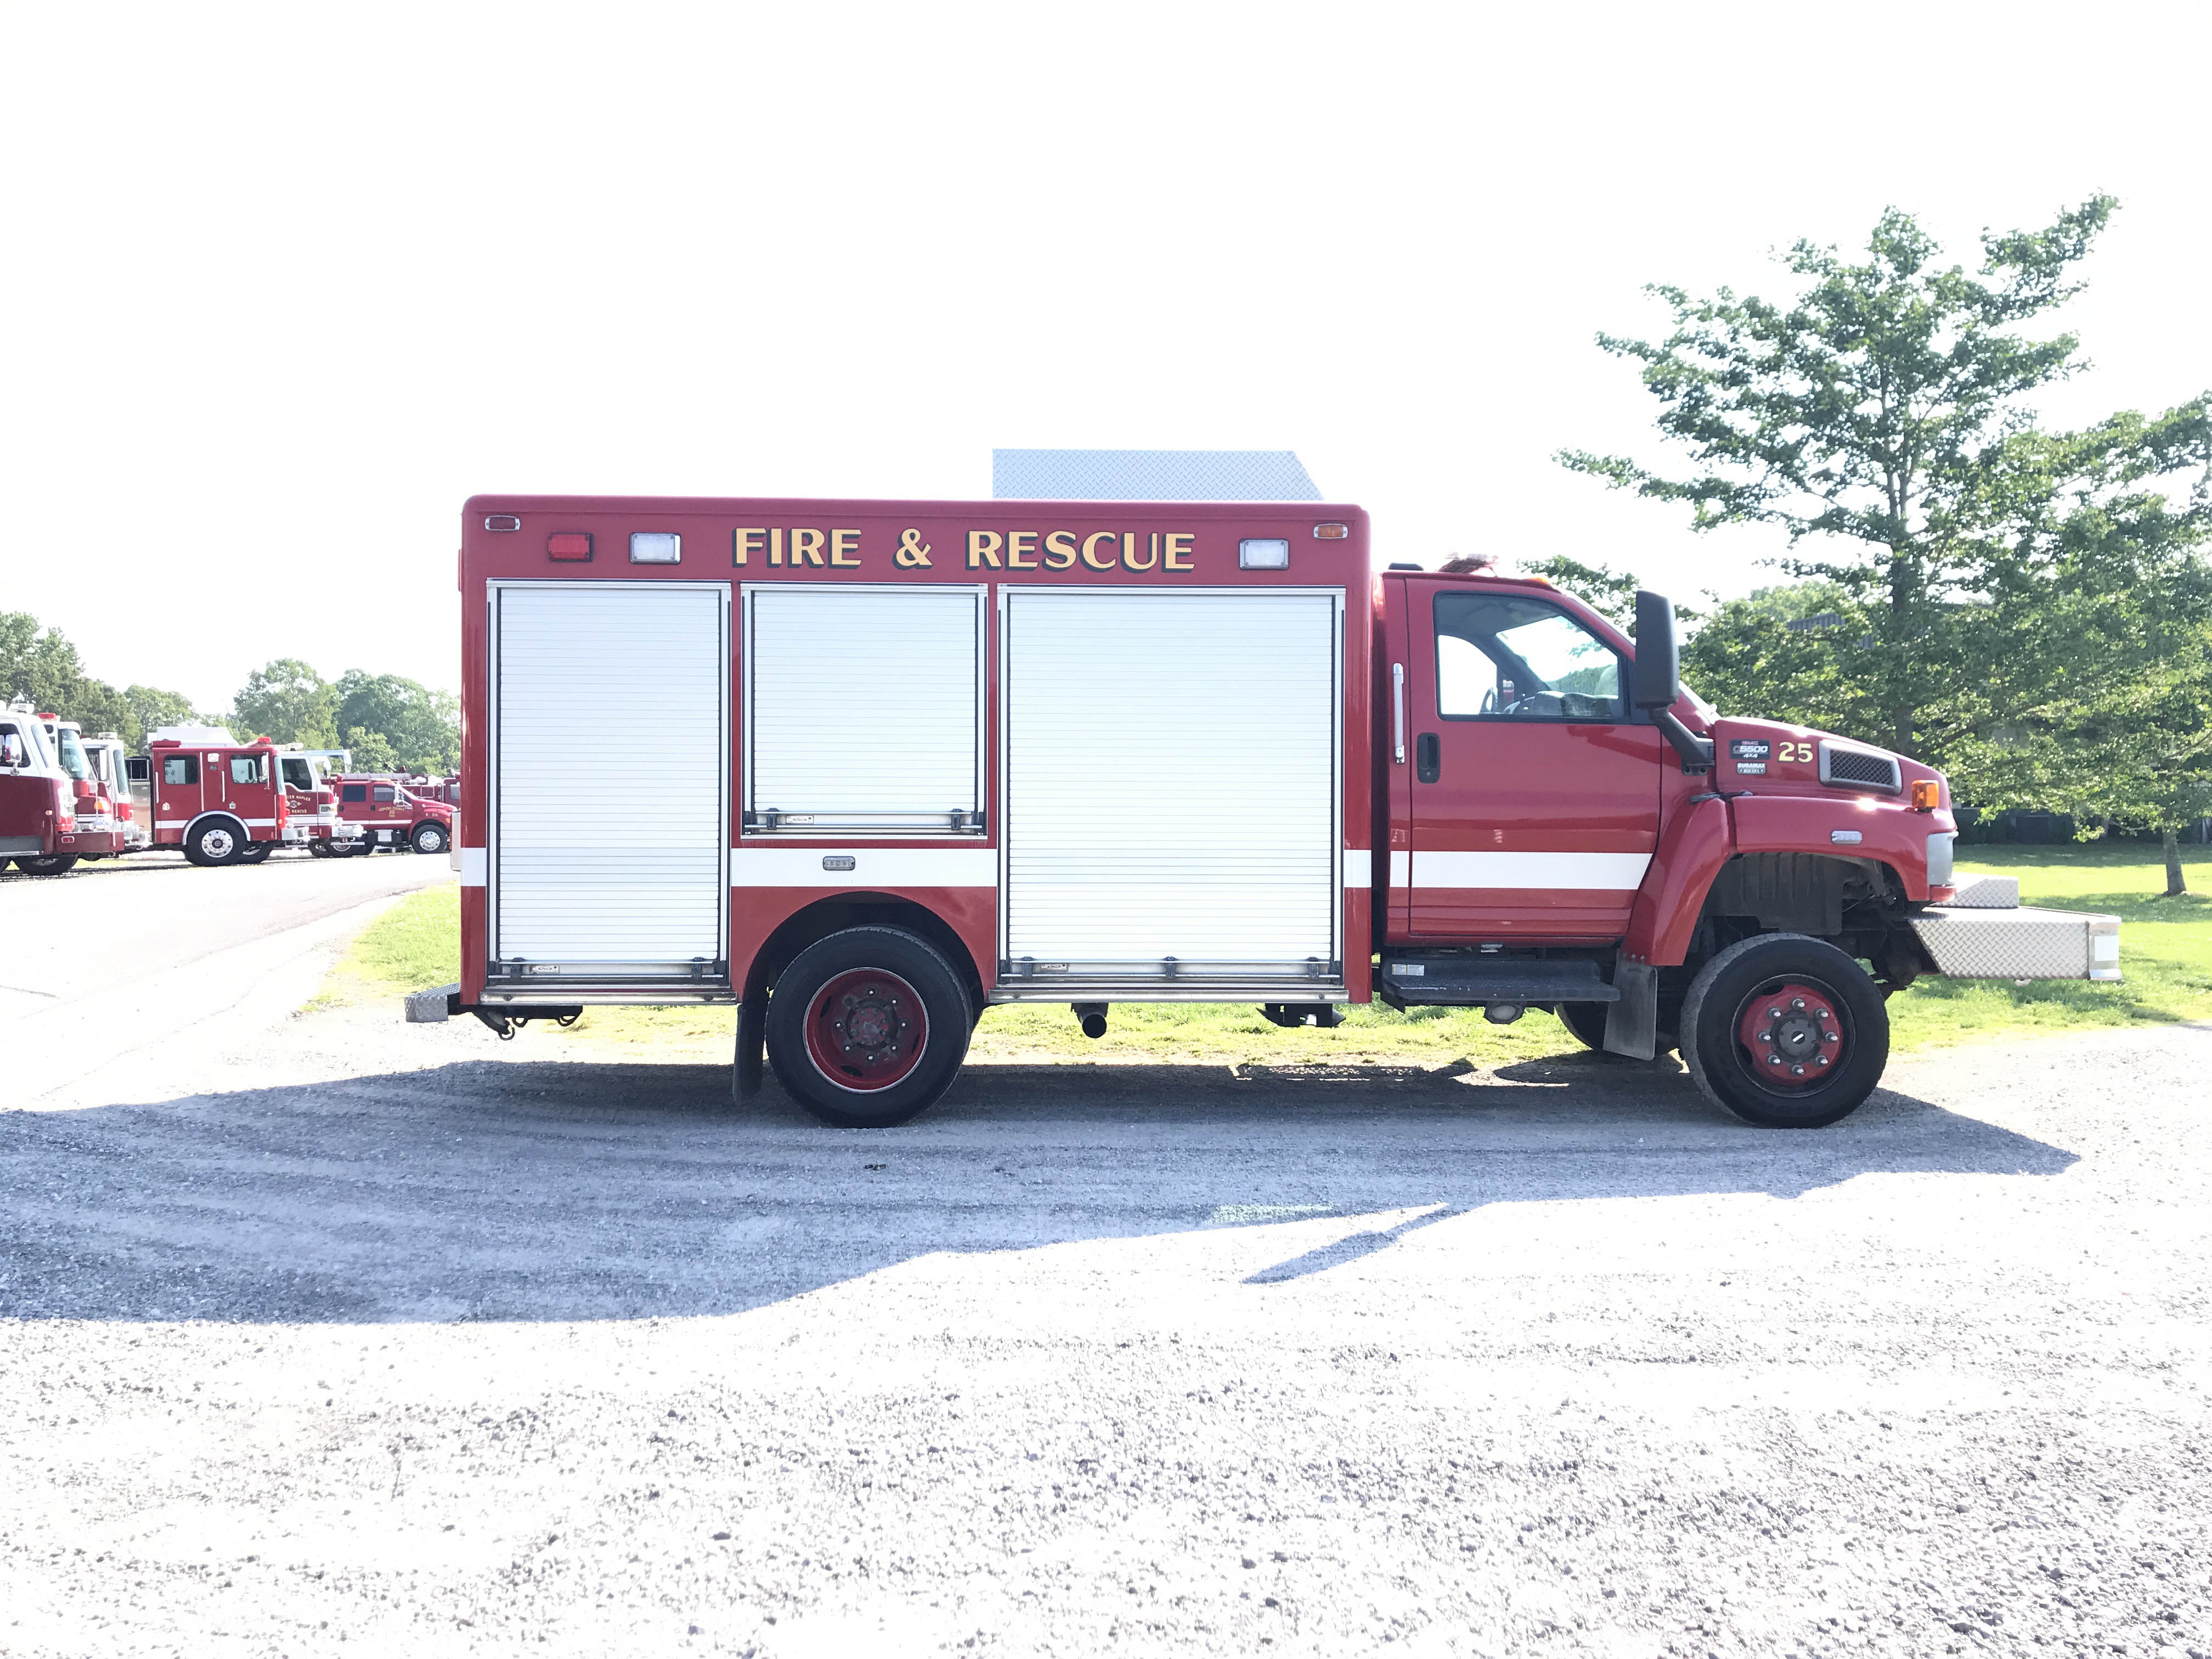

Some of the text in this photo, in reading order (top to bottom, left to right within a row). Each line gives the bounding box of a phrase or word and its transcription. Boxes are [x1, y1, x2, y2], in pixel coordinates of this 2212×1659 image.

[732, 528, 1195, 574] FIRE & RESCUE
[1779, 742, 1813, 763] 25
